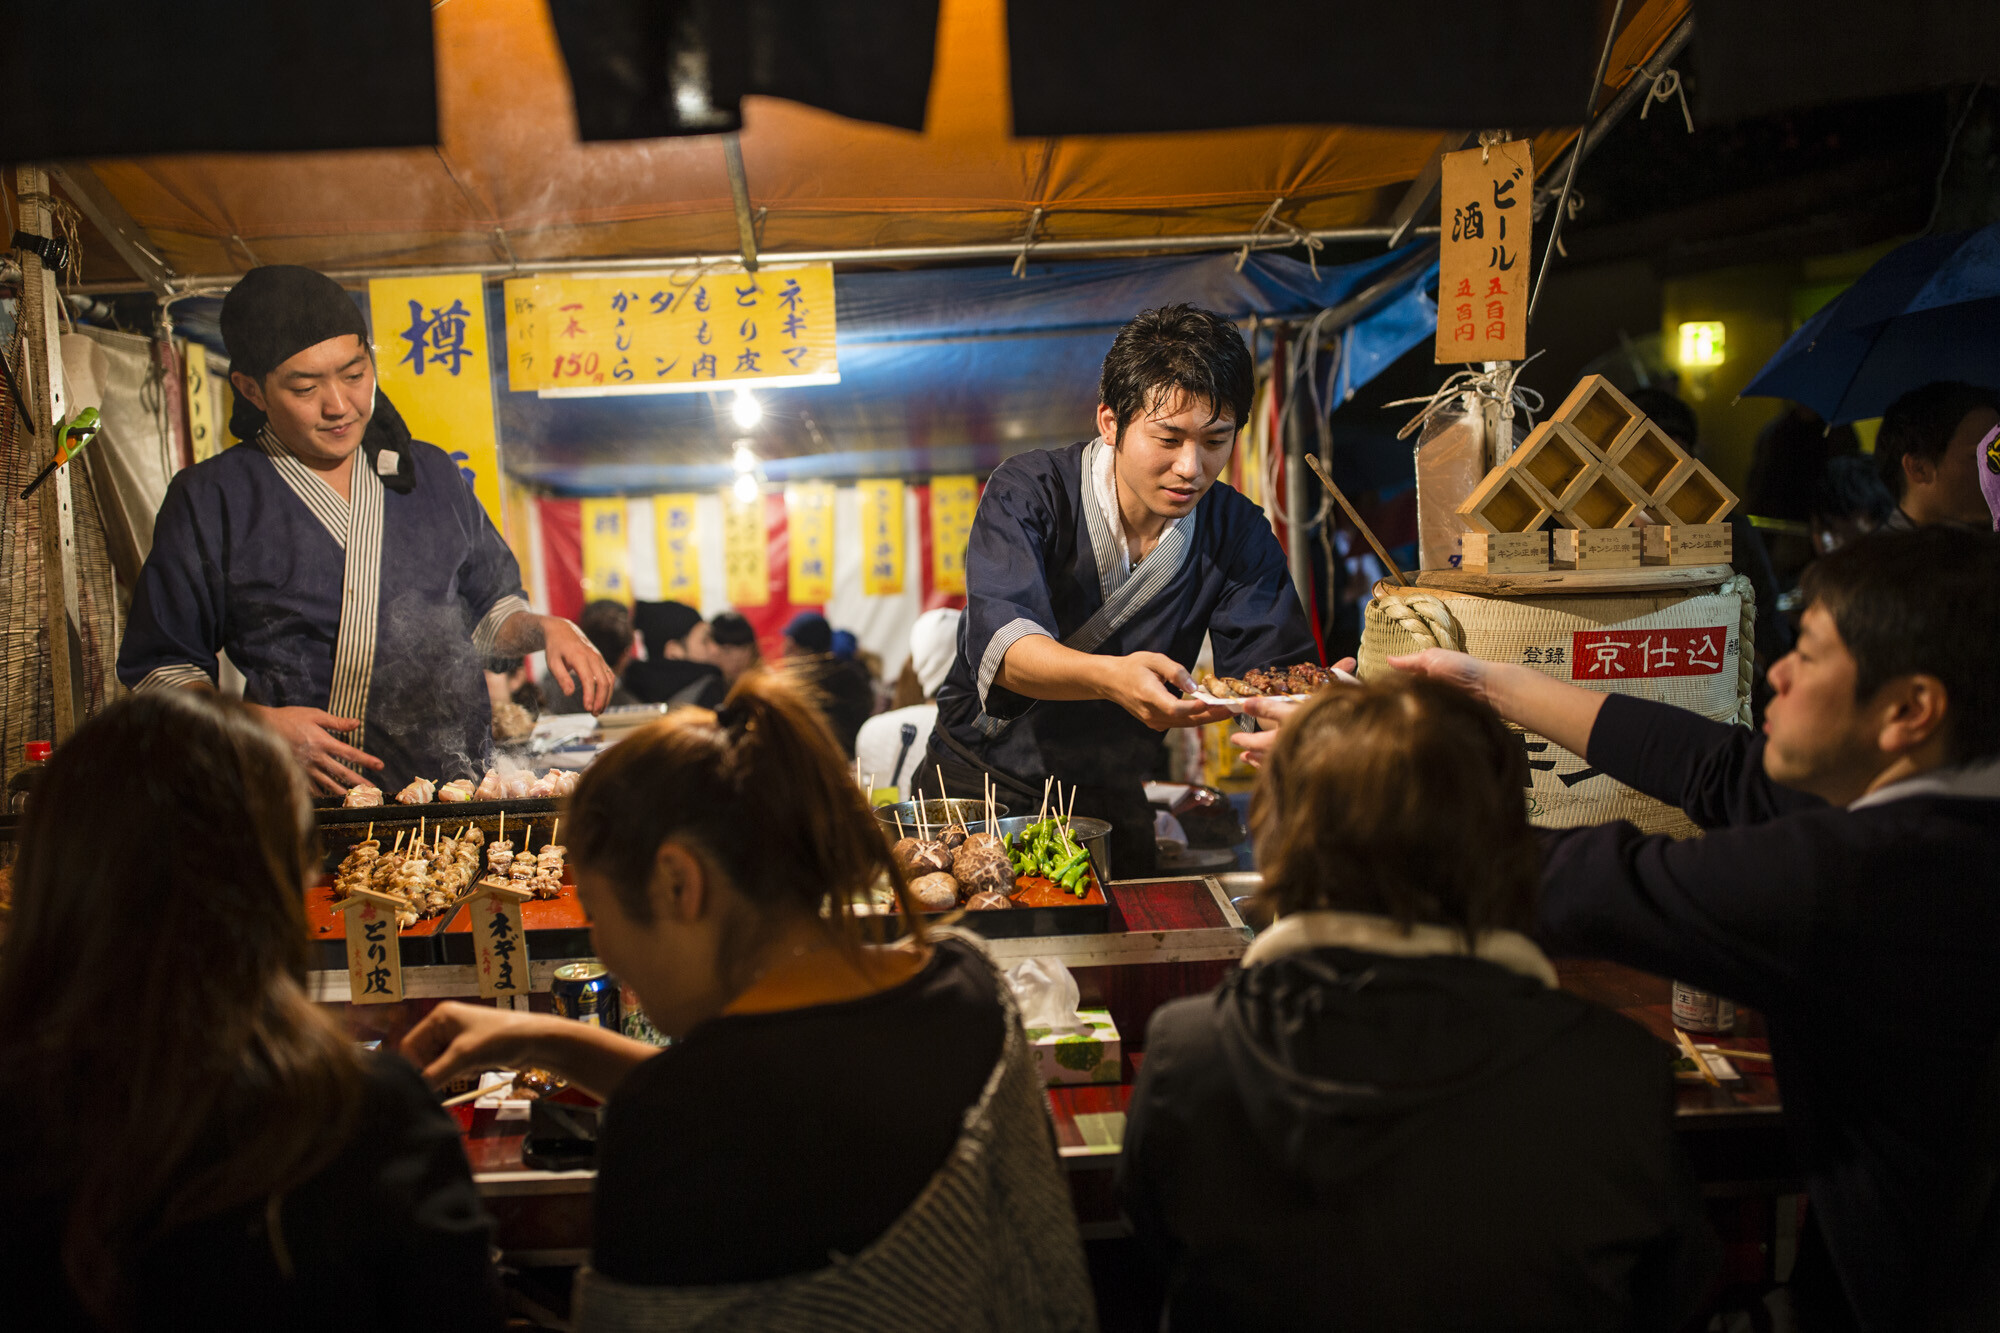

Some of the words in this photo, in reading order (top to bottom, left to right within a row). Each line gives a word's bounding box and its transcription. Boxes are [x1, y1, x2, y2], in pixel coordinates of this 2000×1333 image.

[1451, 201, 1485, 243] 酒
[1488, 168, 1524, 271] ビール
[558, 303, 587, 339] 一本
[611, 289, 639, 382] かしら
[649, 290, 680, 377] タン
[691, 285, 717, 379] もも肉
[732, 285, 763, 373] とり皮
[777, 278, 810, 368] ネギマ
[1455, 278, 1476, 342] 五百円
[1484, 276, 1508, 342] 五百円
[1498, 548, 1539, 558] キンシ正宗
[1588, 544, 1630, 553] キンシ正宗
[1680, 540, 1722, 549] キンシ正宗
[1523, 646, 1566, 665] 登録
[1585, 635, 1720, 675] 京仕込
[361, 920, 394, 995] とり皮
